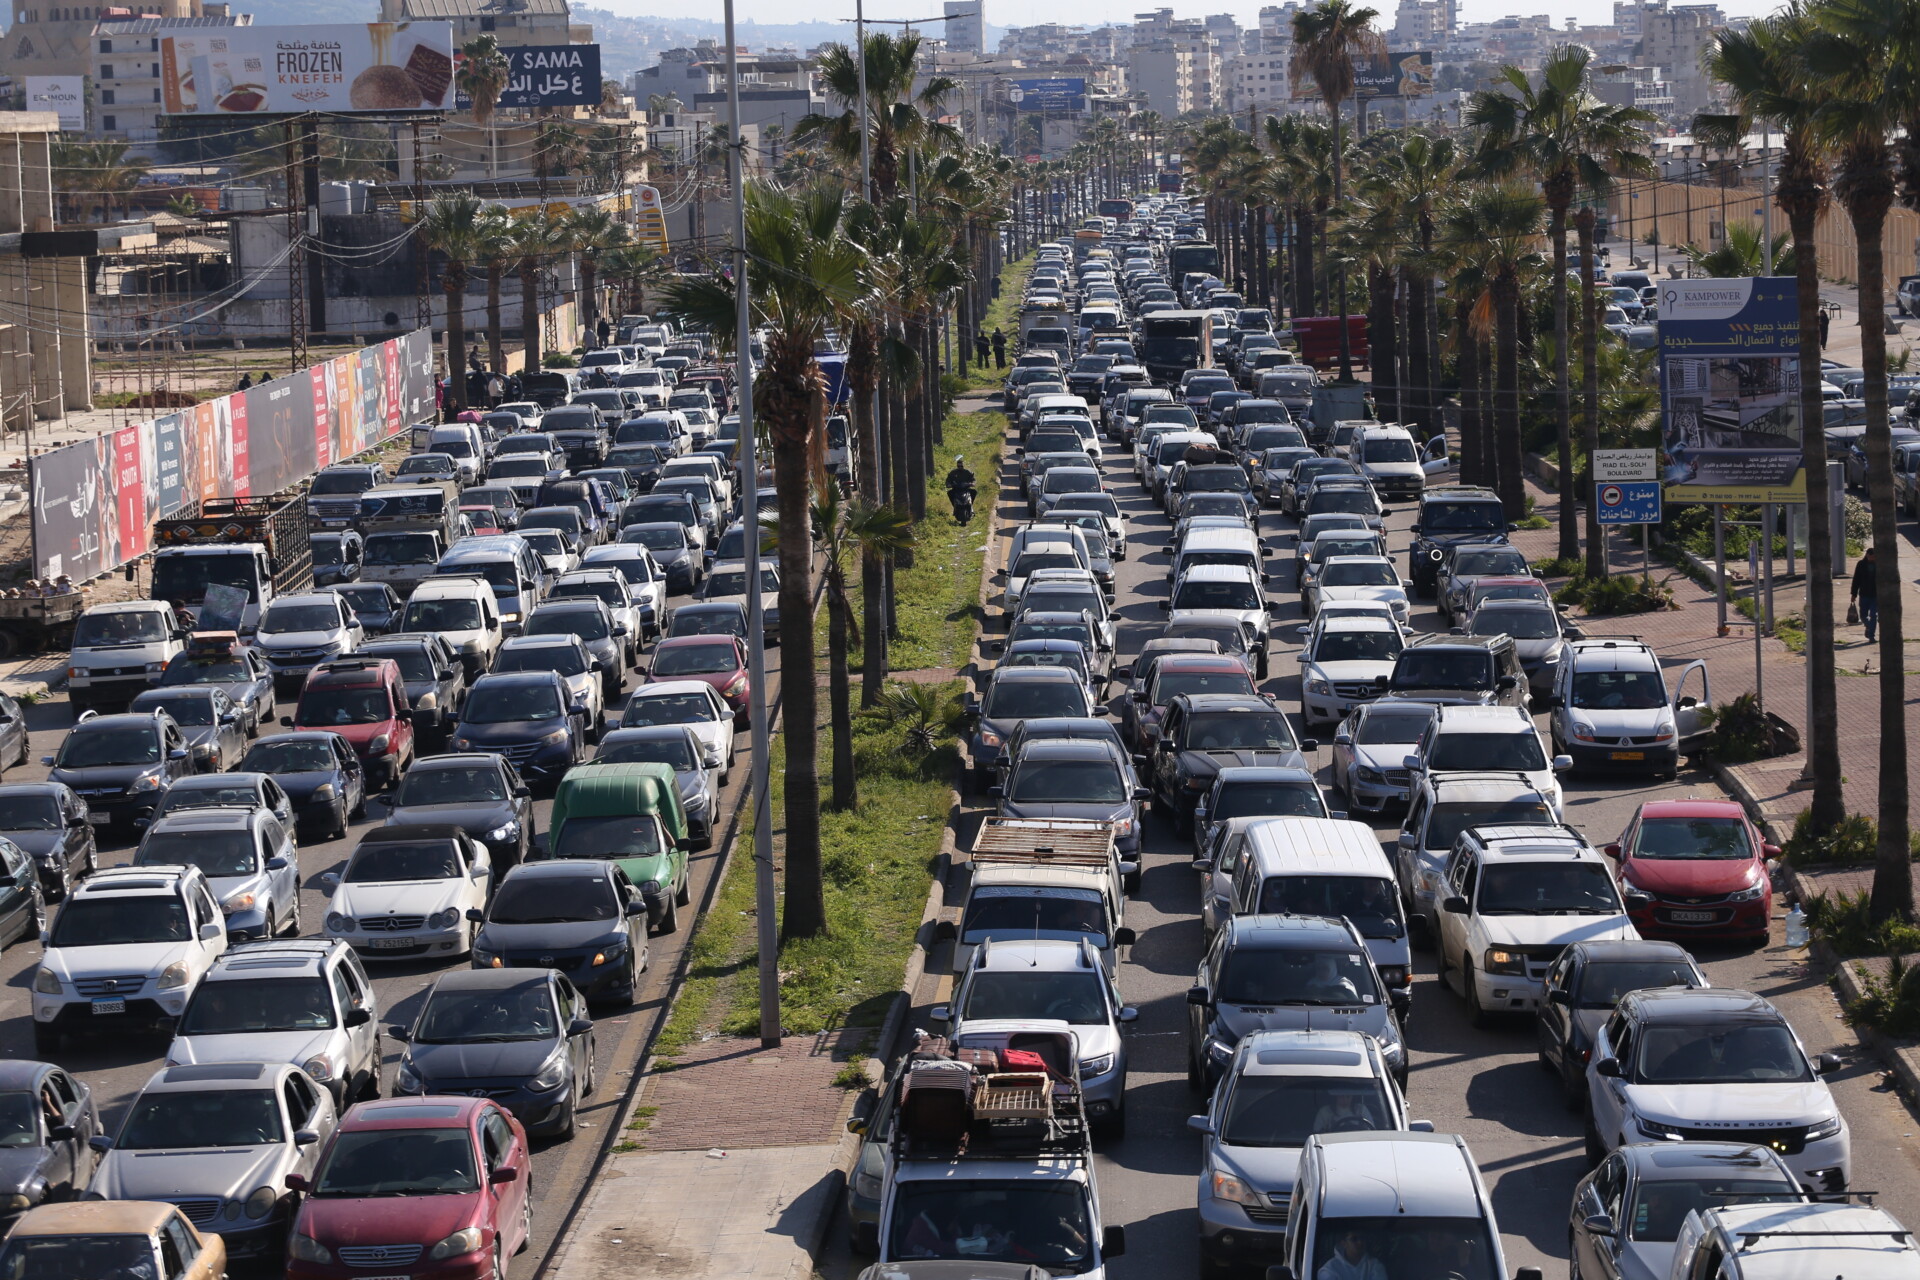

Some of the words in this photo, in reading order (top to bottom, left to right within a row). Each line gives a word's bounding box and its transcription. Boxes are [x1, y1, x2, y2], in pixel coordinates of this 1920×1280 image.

[276, 40, 309, 51] مثلجة
[310, 40, 341, 50] كنافة
[277, 52, 342, 73] FROZEN
[523, 51, 583, 69] SAMA
[278, 73, 343, 84] KNEFEH
[1374, 74, 1395, 85] أطيب
[1684, 291, 1741, 301] KAMPOWER
[1753, 323, 1774, 333] جميع
[1744, 335, 1774, 347] الأعمال
[1596, 453, 1616, 462] الصلح
[121, 465, 138, 488] SOUTH
[1629, 489, 1655, 501] ممنوع
[1600, 507, 1636, 519] الشاحنات
[1640, 510, 1658, 521] مرور
